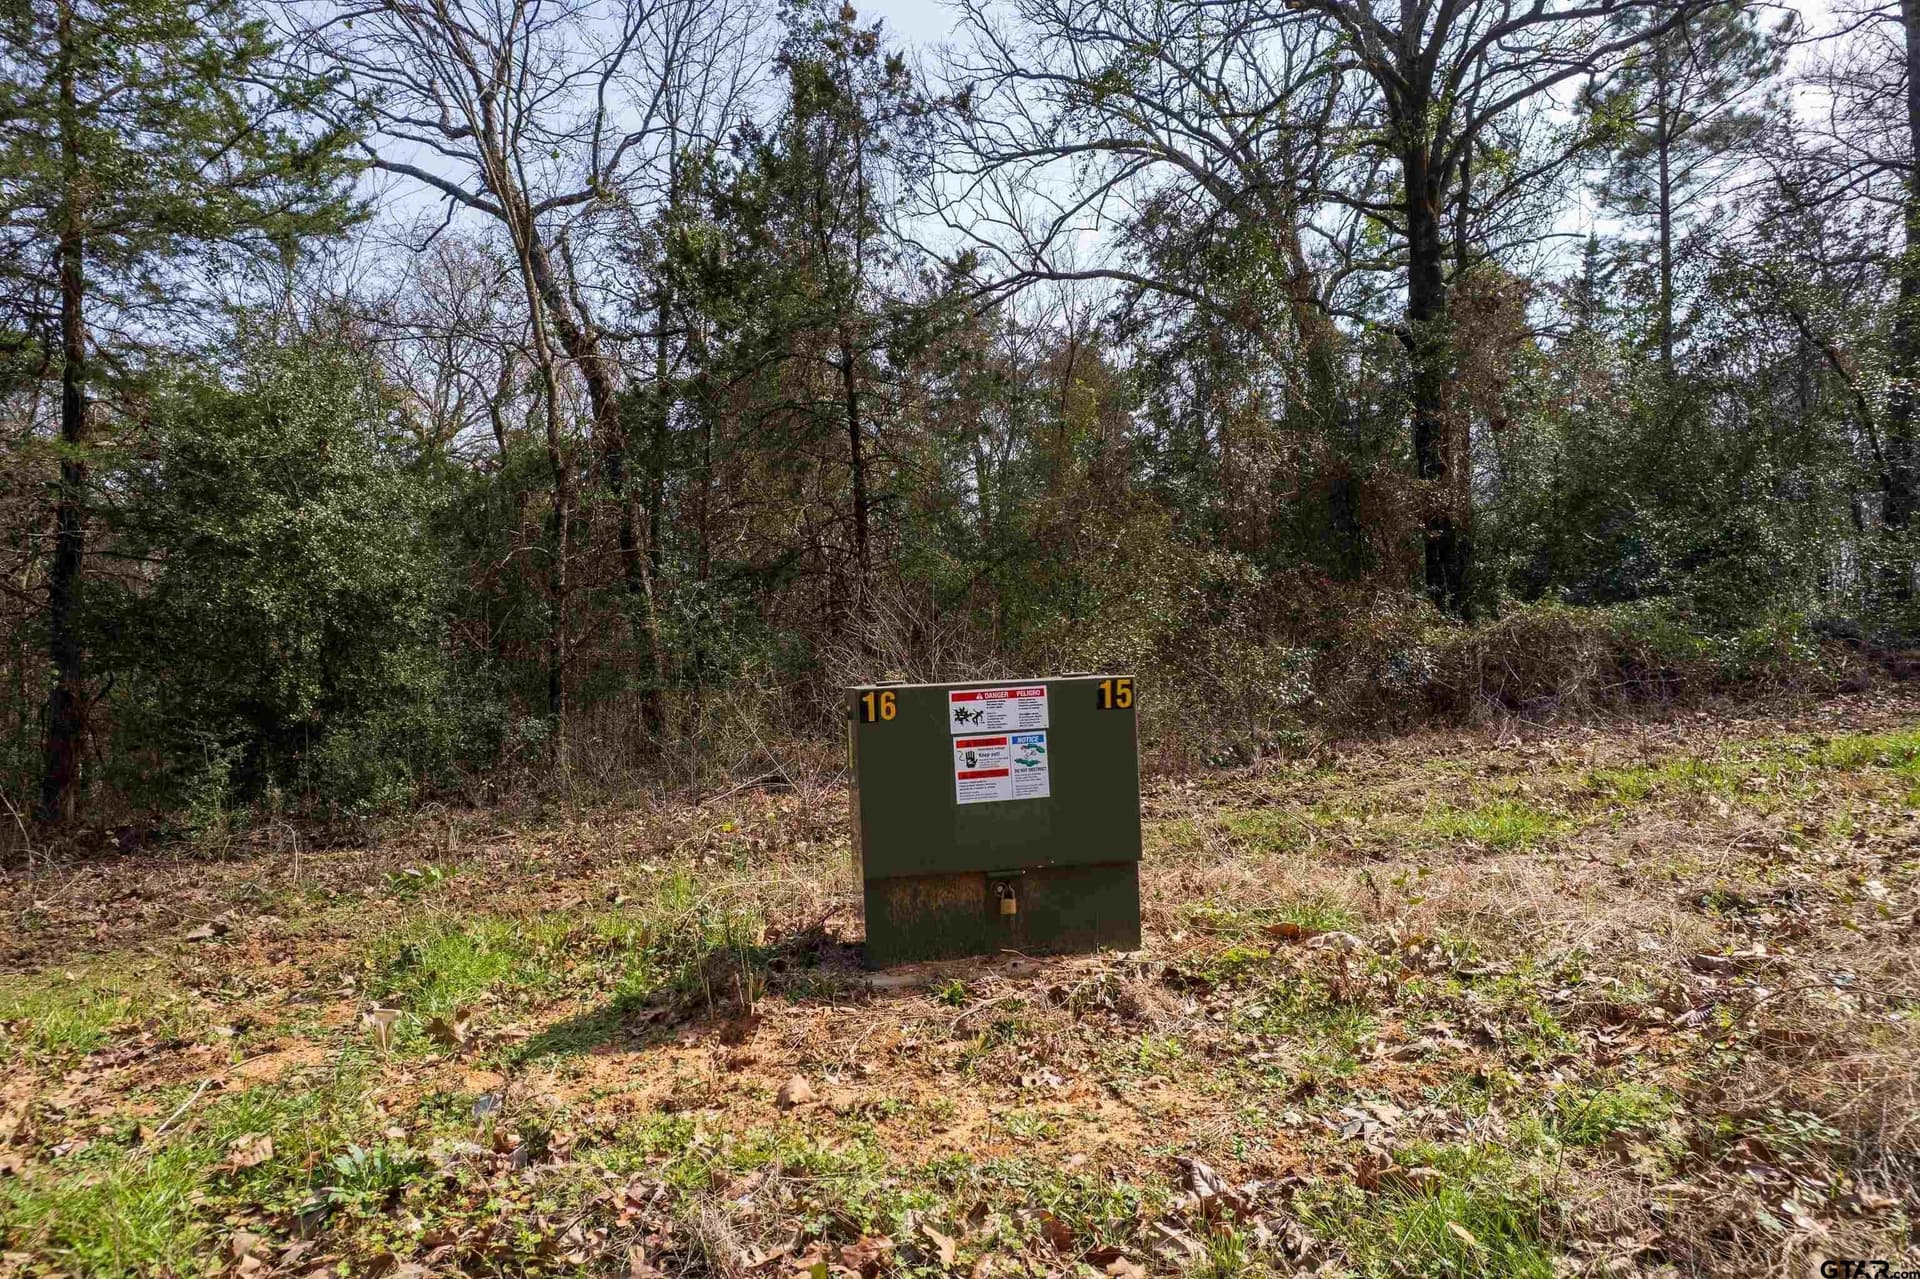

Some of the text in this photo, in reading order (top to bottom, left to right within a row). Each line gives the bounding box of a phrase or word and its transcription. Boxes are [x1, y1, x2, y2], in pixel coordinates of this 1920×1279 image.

[984, 689, 1041, 700] DANGER PELIGRO
[1100, 679, 1132, 709] 15
[862, 691, 895, 721] 16
[1017, 736, 1039, 744] NOTICE
